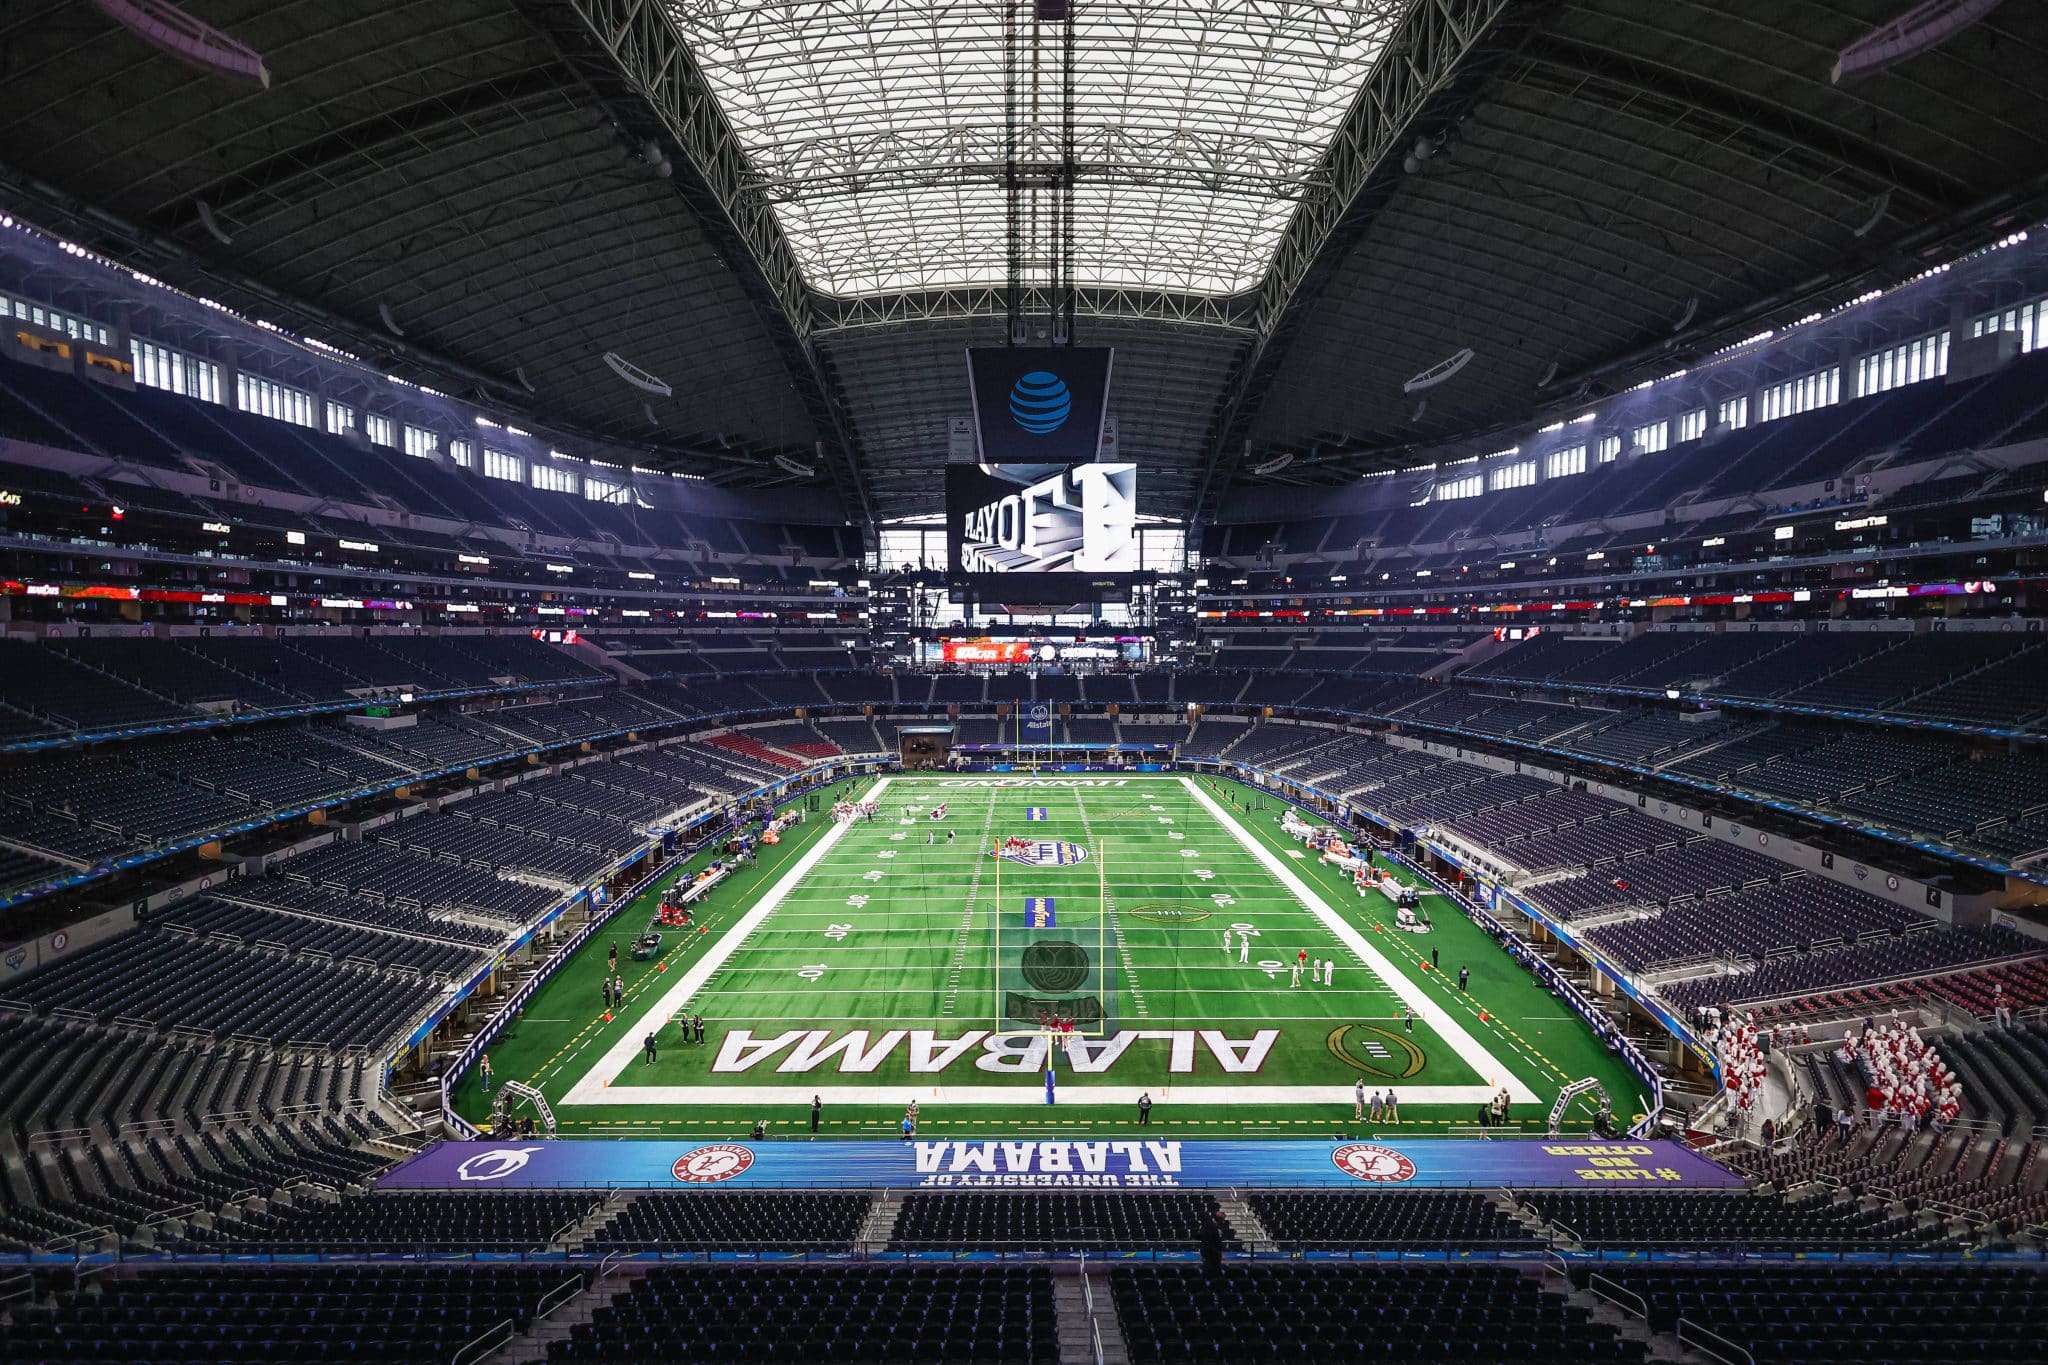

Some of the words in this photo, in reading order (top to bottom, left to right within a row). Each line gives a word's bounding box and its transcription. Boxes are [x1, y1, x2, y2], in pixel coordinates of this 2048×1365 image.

[0, 490, 22, 505] CATS
[938, 780, 1129, 788] CINCINNATI
[846, 894, 870, 906] 30
[1210, 893, 1237, 905] 30
[824, 923, 853, 938] 20
[1230, 923, 1262, 937] 20
[797, 963, 829, 978] 10
[1257, 960, 1289, 973] 10
[712, 1029, 1280, 1073] ALABAMA
[914, 1141, 1182, 1173] ALABAMA
[1541, 1145, 1654, 1156] OTHER
[1588, 1157, 1639, 1167] NO
[675, 1164, 744, 1182] ALABAMA
[1342, 1164, 1412, 1181] ALABAMA
[920, 1174, 953, 1187] OF
[957, 1174, 1119, 1187] UNIVERSITY
[1125, 1174, 1179, 1187] THE
